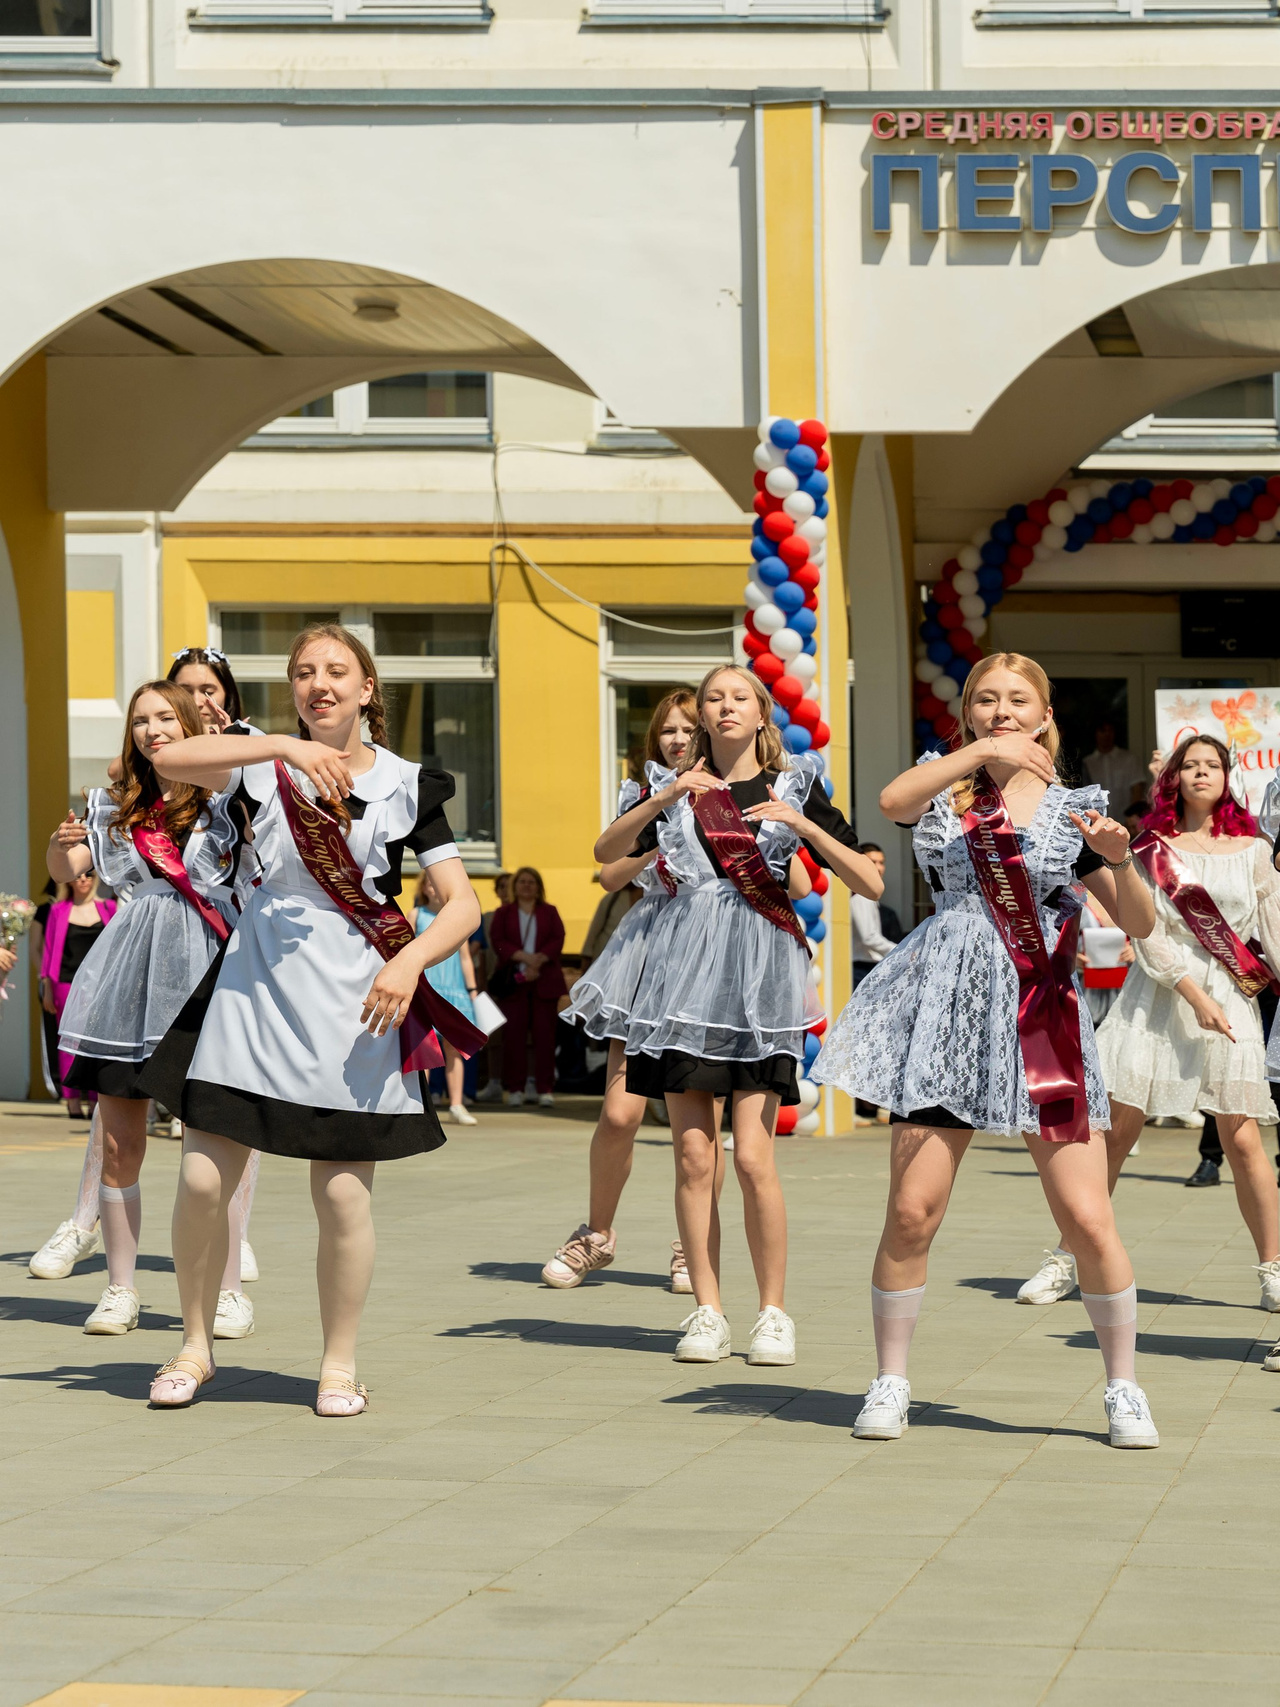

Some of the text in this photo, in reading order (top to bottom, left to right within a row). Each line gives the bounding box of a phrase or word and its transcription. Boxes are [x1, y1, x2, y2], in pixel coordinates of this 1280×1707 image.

[870, 110, 1055, 145] СРЕДНЯЯ
[969, 792, 1021, 915] Выпускница
[1186, 896, 1263, 991] Выпускница
